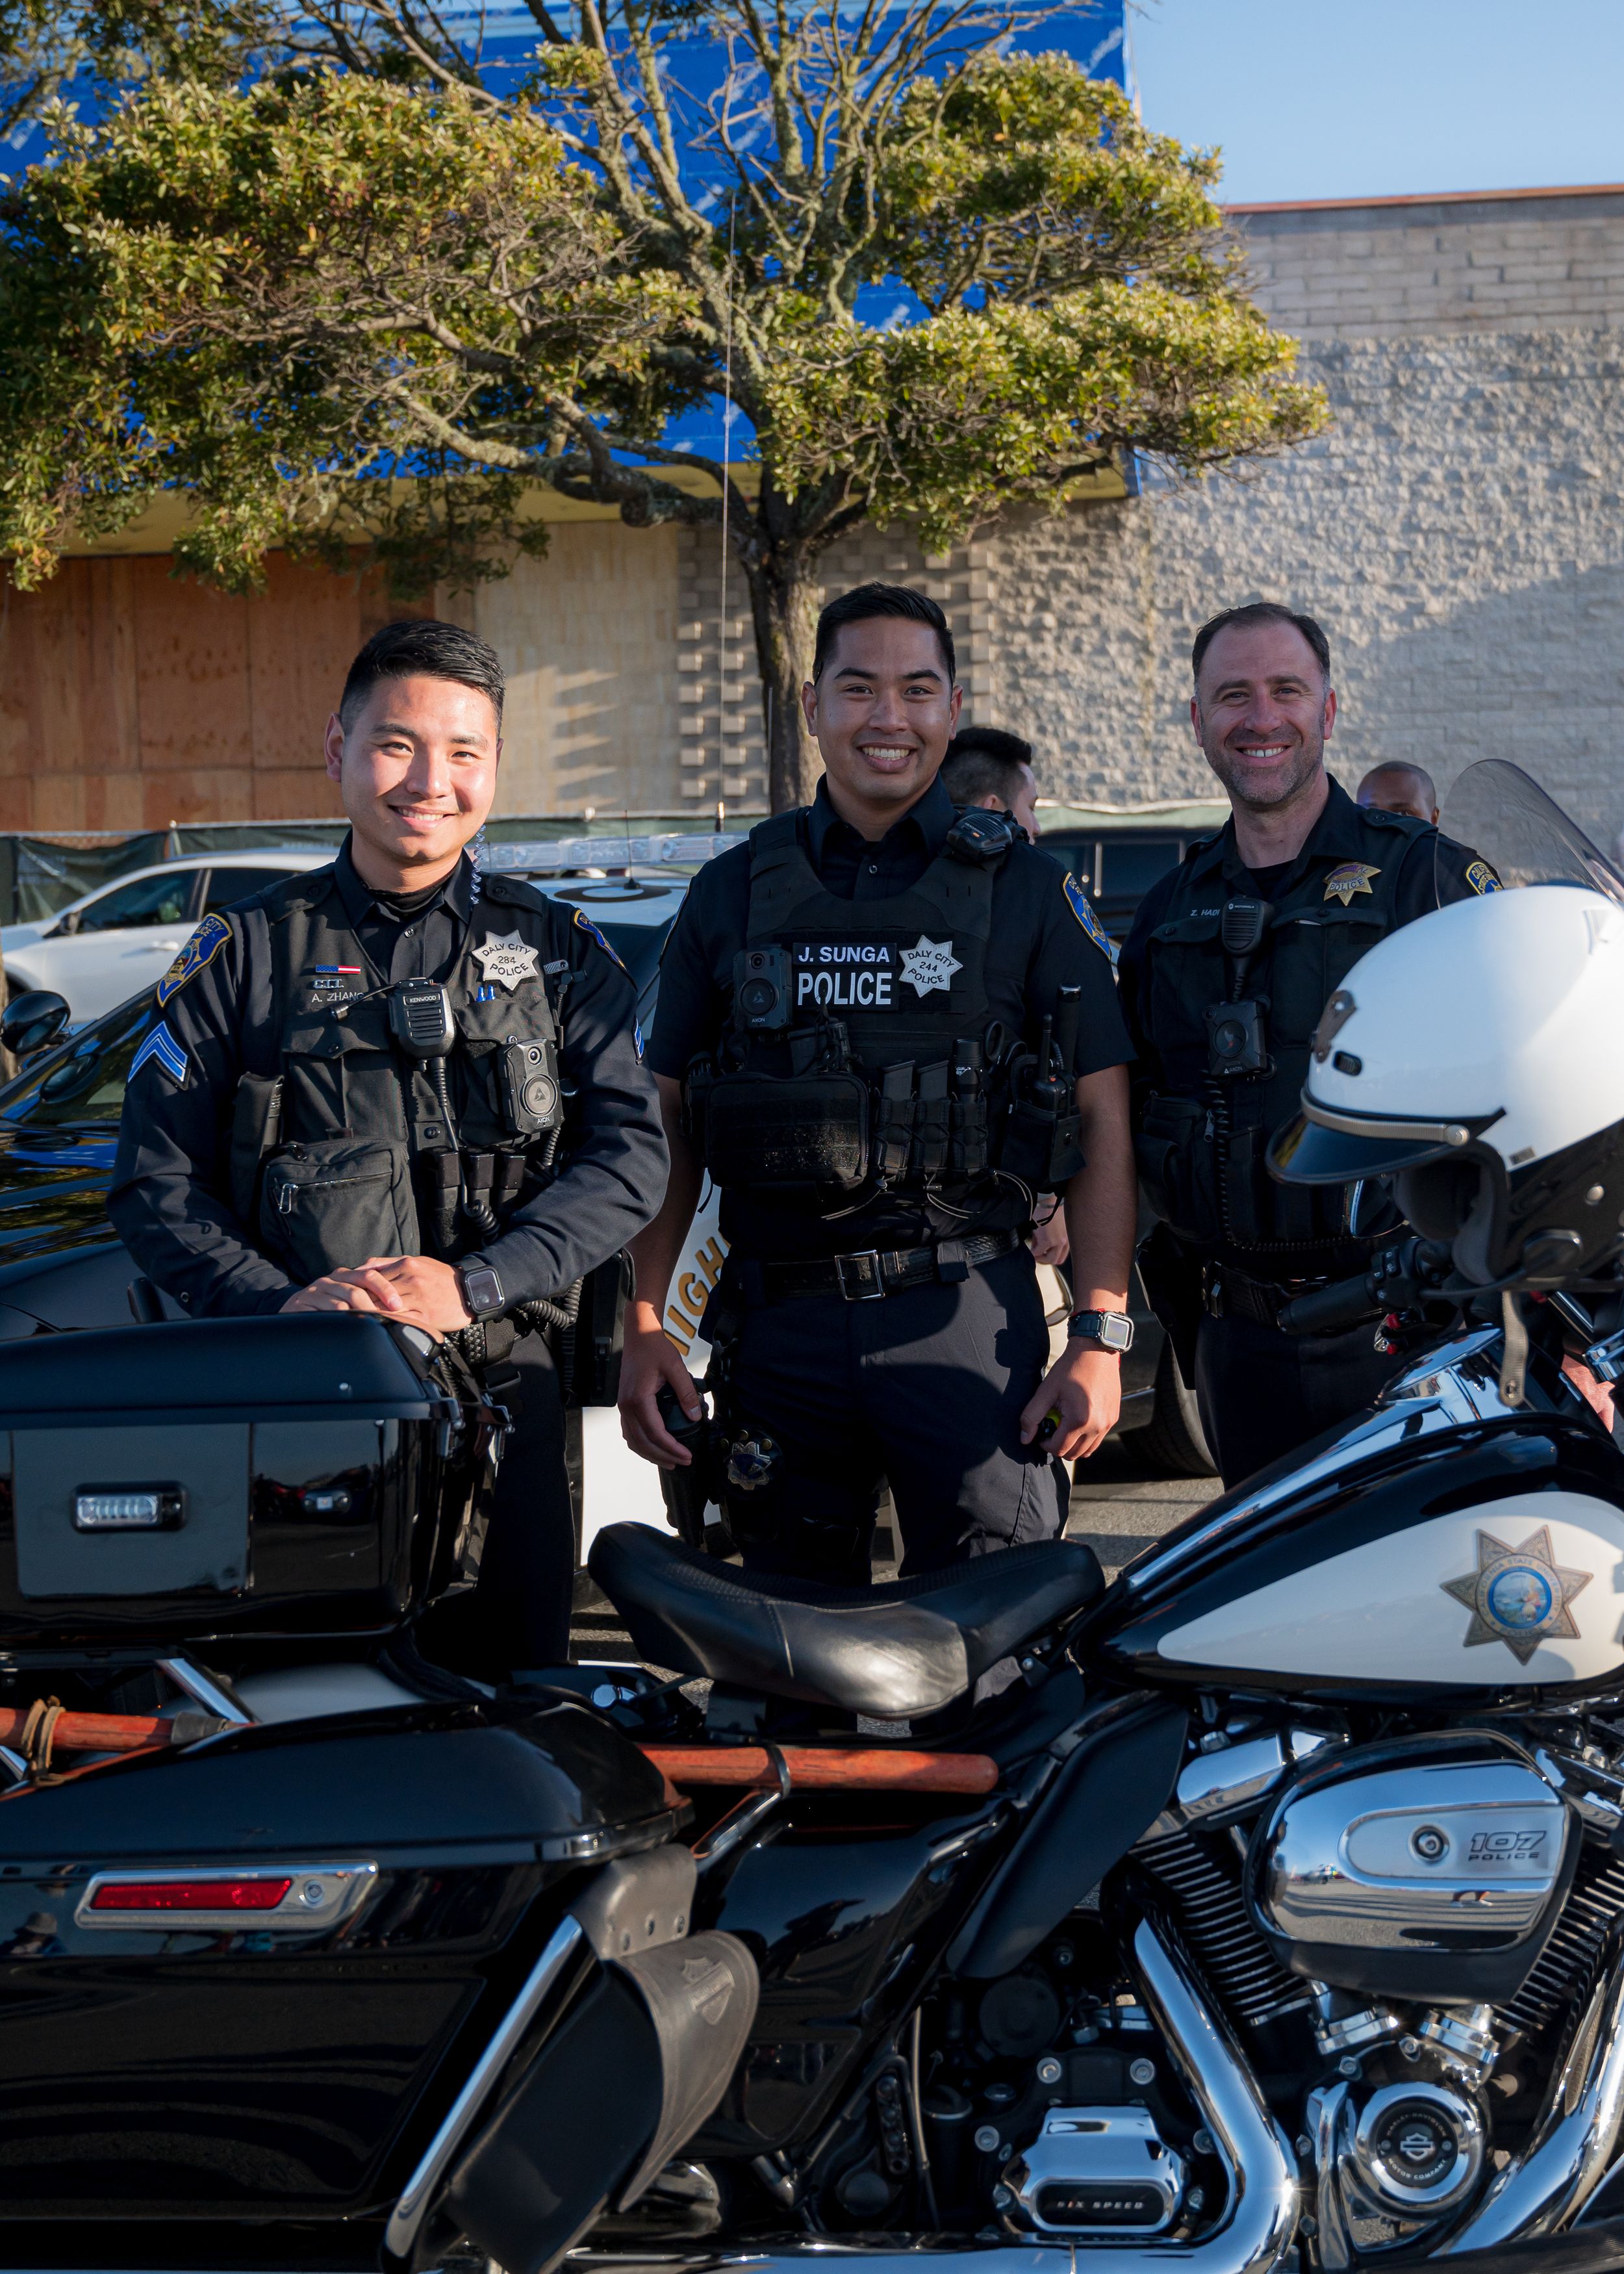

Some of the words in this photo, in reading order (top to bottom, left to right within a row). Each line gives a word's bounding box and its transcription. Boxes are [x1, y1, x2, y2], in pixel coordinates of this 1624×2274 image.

[1330, 878, 1365, 891] POLICE
[206, 918, 224, 932] CITY
[482, 943, 505, 956] DALY
[508, 943, 531, 954] CITY
[798, 947, 814, 962] J.
[819, 947, 890, 962] SUNGA
[907, 951, 932, 960] DALY
[935, 953, 954, 967] CITY
[490, 963, 529, 976] POLICE
[919, 962, 937, 972] 244
[907, 968, 945, 984] POLICE
[798, 972, 892, 1005] POLICE
[311, 993, 323, 1003] A.
[1471, 1830, 1547, 1852] 107
[1468, 1852, 1540, 1861] POLICE
[1388, 2158, 1412, 2178] MOTOR
[1413, 2159, 1446, 2180] COMPANY
